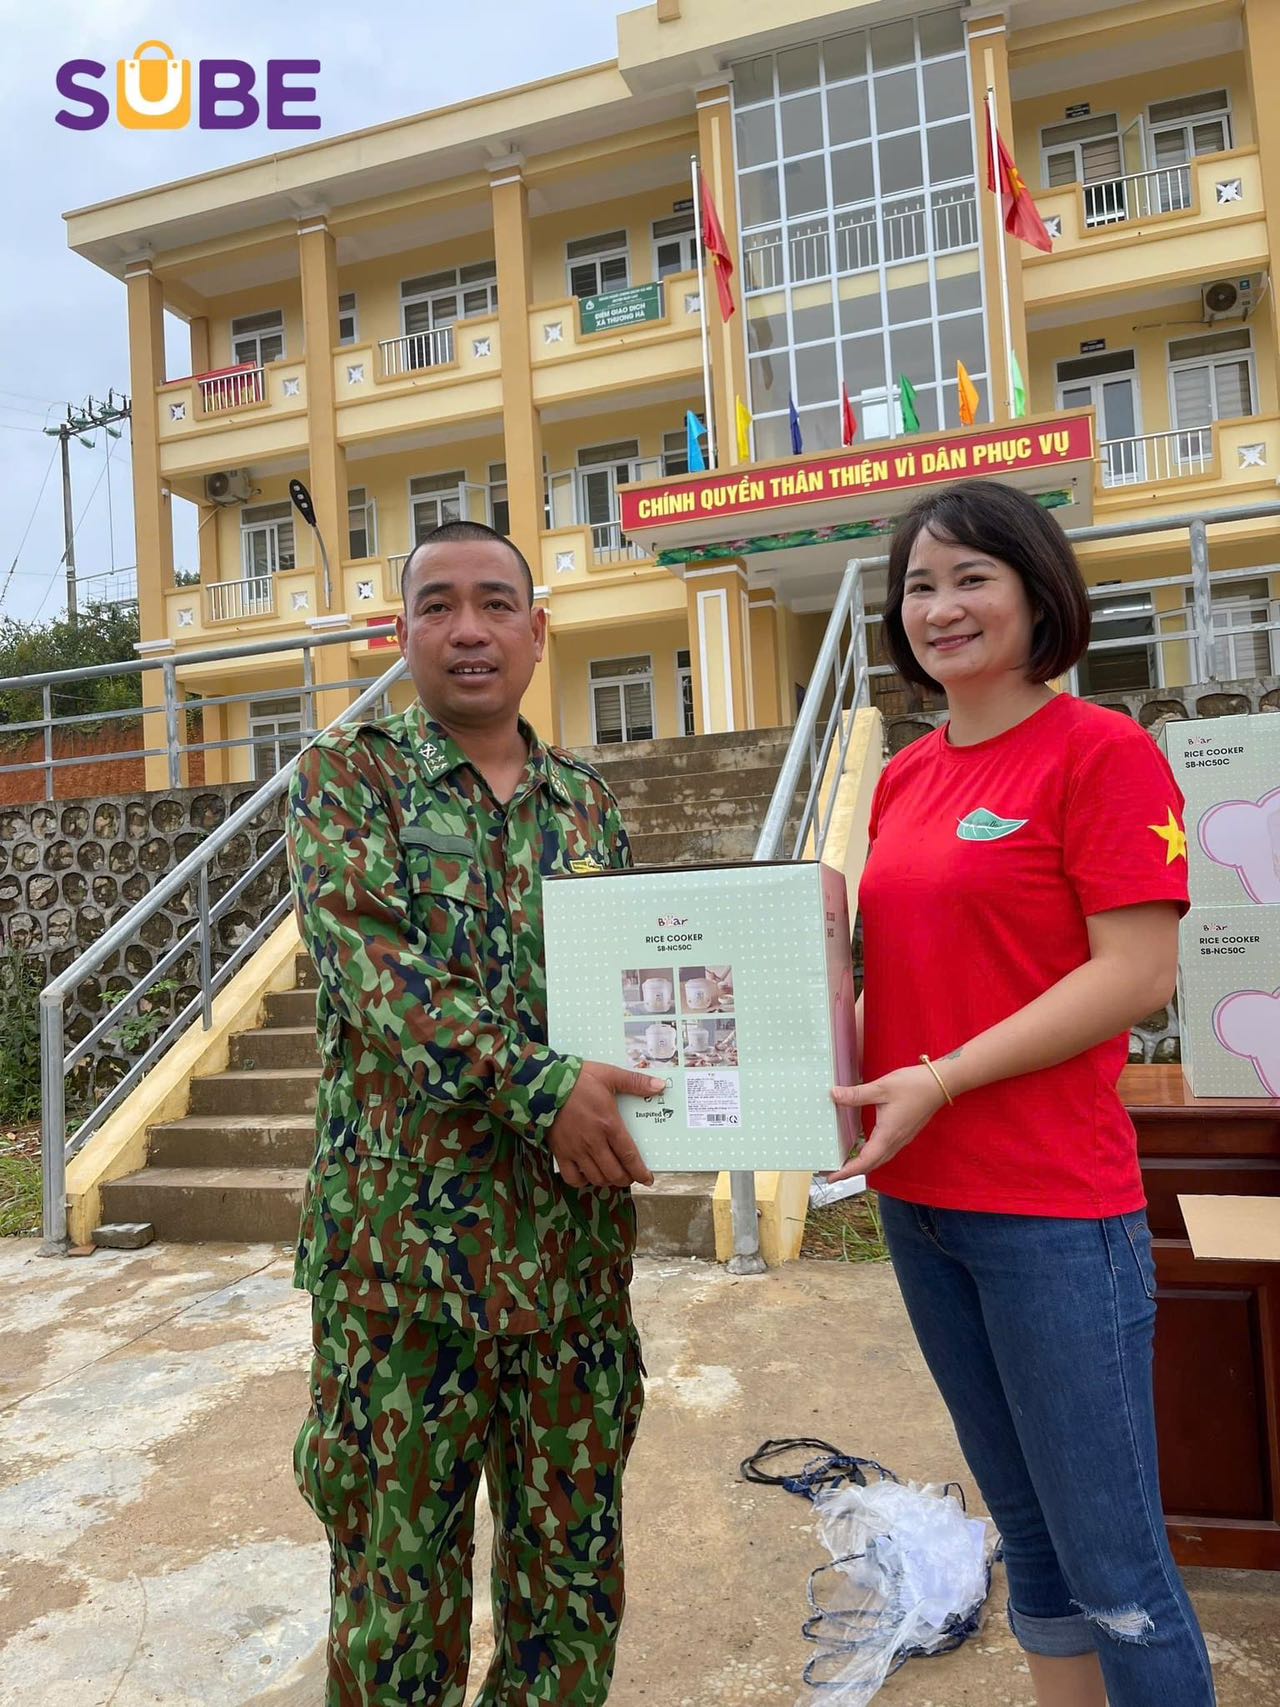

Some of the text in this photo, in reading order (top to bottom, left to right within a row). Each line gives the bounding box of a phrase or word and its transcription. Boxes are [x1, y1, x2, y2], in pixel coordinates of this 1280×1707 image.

[638, 430, 1069, 519] CHÍNH QUYỀN THÂN THIỆN VÌ DÂN PHỤC VỤ
[1184, 746, 1244, 758] RICE COOKER
[1185, 758, 1230, 768] SB-NC50C
[645, 933, 703, 943] RICE COOKER
[657, 944, 692, 952] SB-NC50C
[1200, 947, 1246, 955] SB-NC50C
